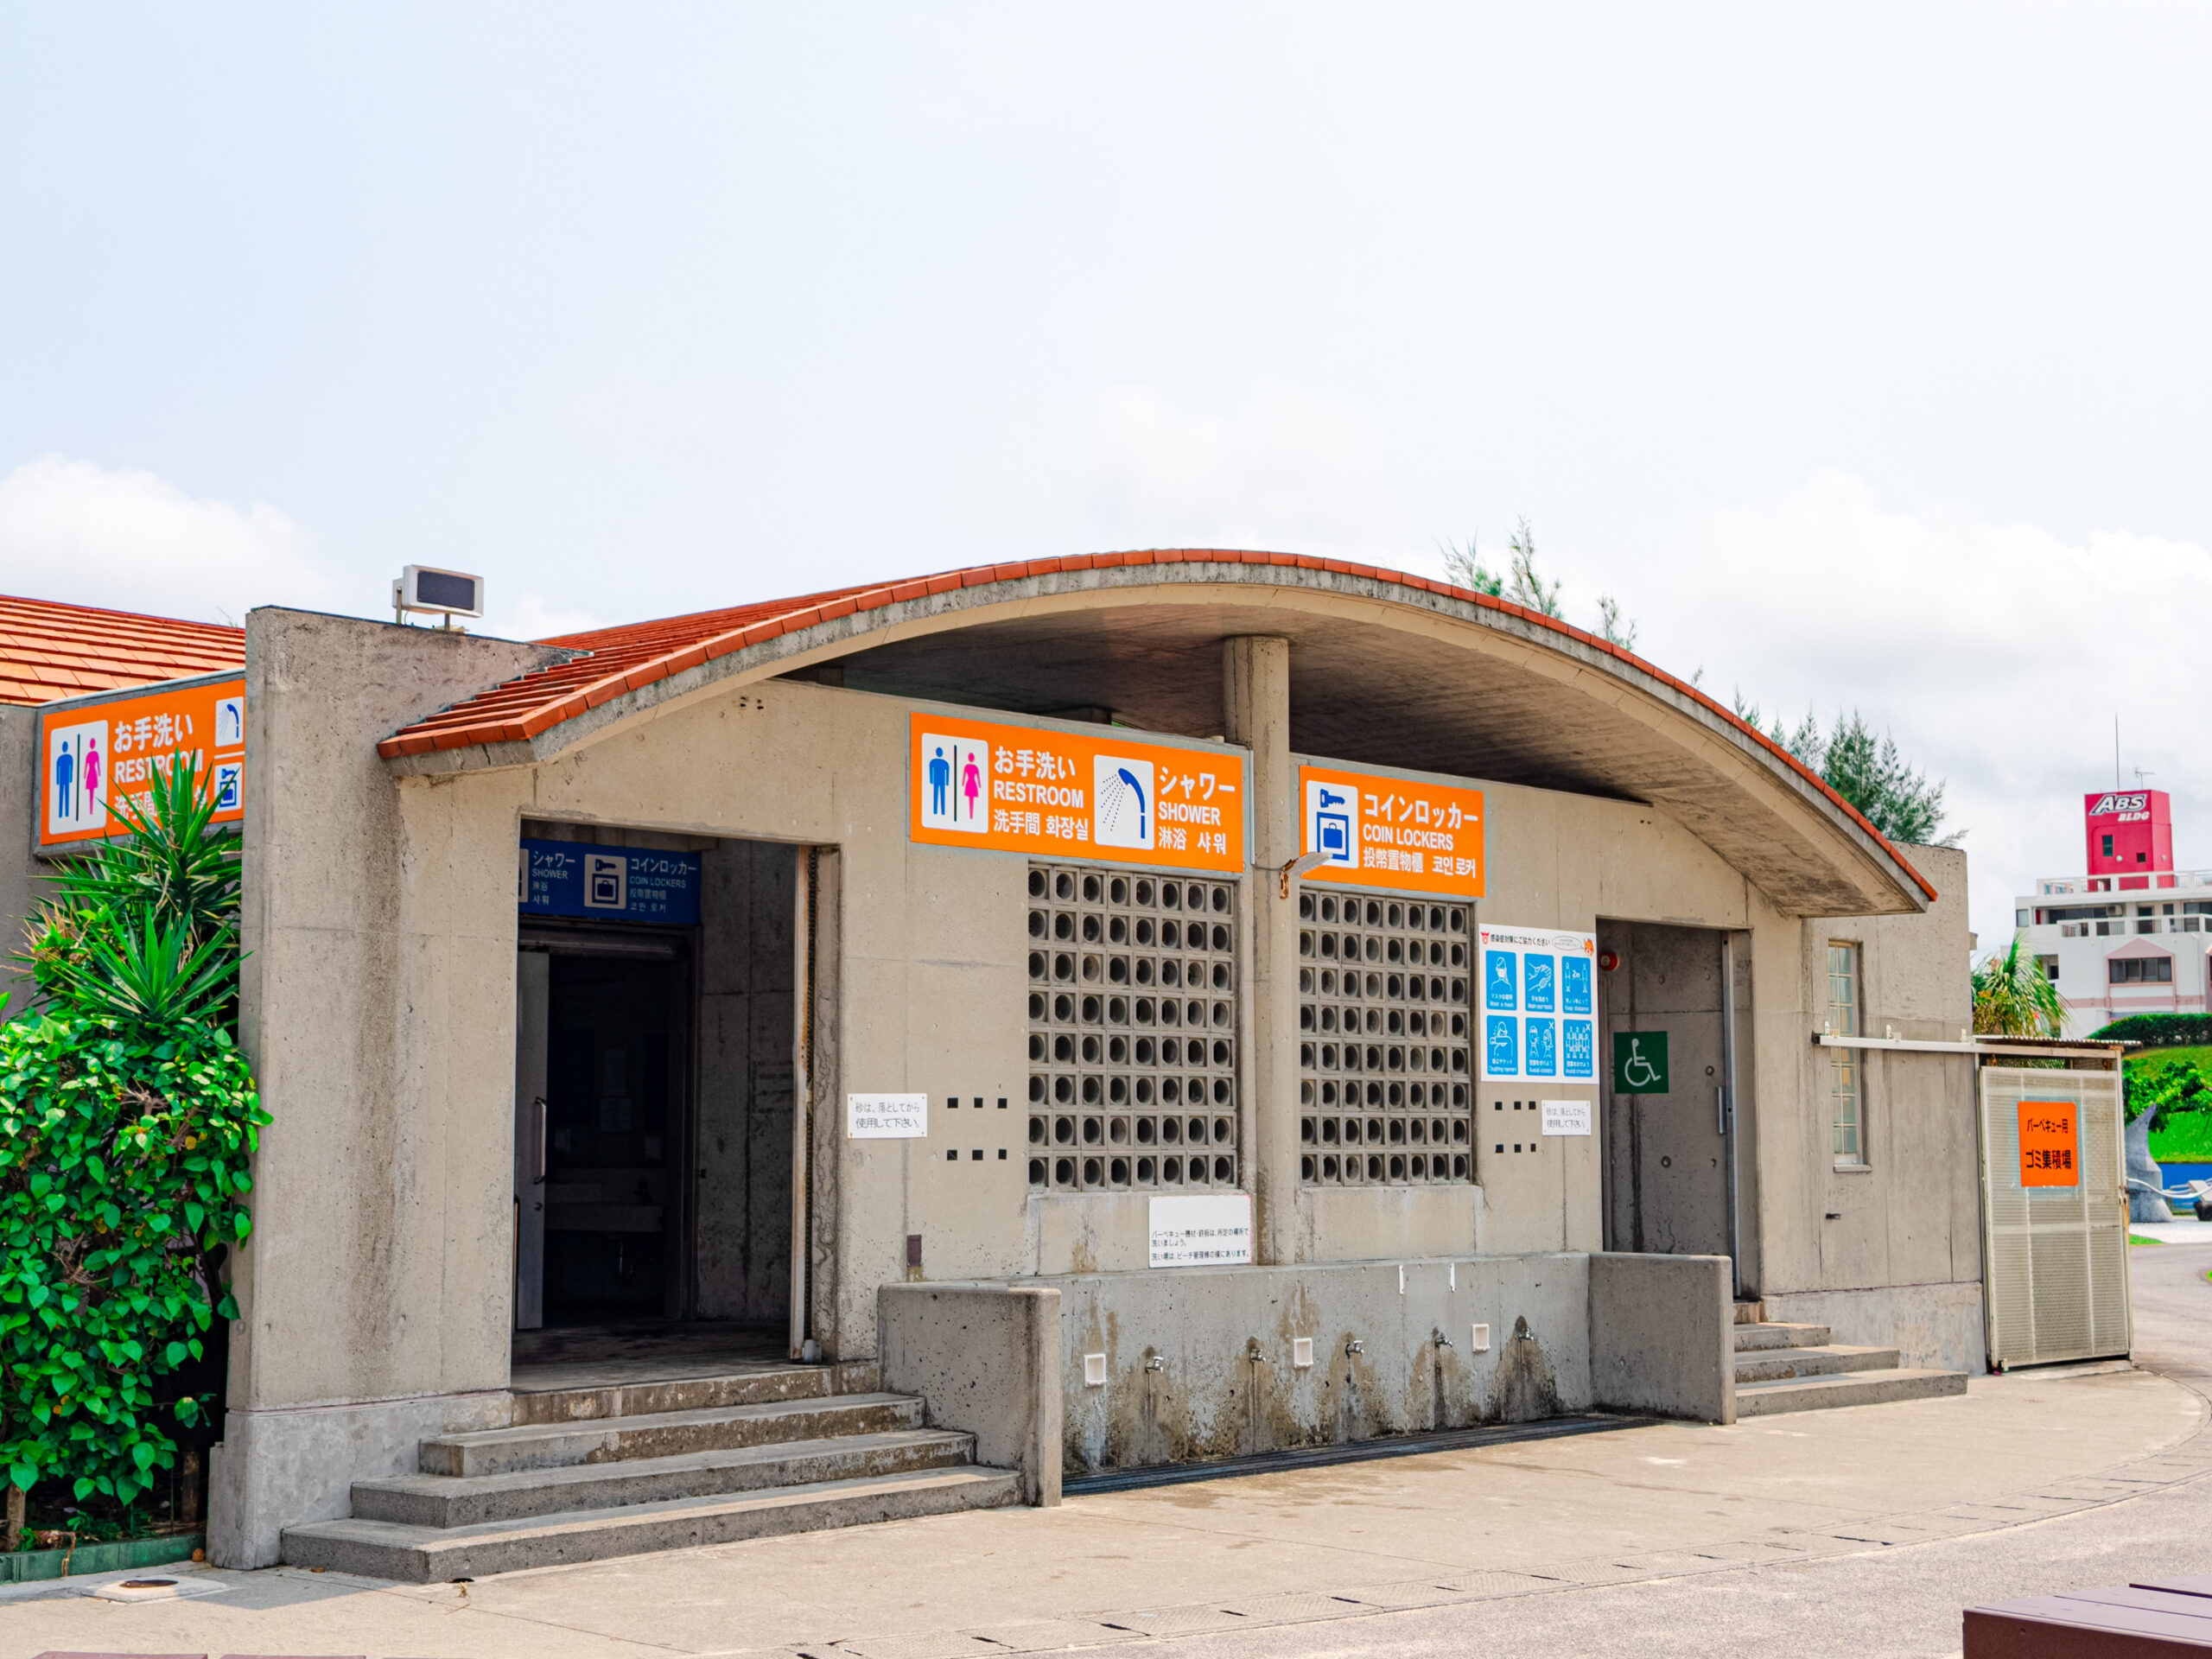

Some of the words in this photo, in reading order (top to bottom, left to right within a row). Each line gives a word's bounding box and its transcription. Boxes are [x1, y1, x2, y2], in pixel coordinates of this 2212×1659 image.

[113, 713, 194, 753] お手洗い
[994, 745, 1076, 780] お手洗い
[994, 779, 1084, 809] RESTROOM
[1159, 766, 1236, 800] シャワー
[1159, 801, 1221, 826] SHOWER
[1363, 793, 1478, 830] コインロッカー
[2088, 794, 2147, 816] ABS
[2118, 811, 2150, 822] BLDG
[994, 808, 1040, 836] 洗手間
[1046, 815, 1089, 841] 화장실
[1159, 826, 1187, 850] 淋浴
[1198, 831, 1226, 855] 샤워
[1363, 823, 1394, 844] COIN
[1396, 828, 1453, 851] LOCKERS
[532, 850, 575, 868] シャワー
[631, 858, 697, 875] コインロッカー
[1432, 855, 1453, 876] 코인
[1455, 858, 1477, 879] 로커
[532, 868, 569, 880] SHOWER
[630, 876, 648, 886] COIN
[651, 878, 686, 888] LOCKERS
